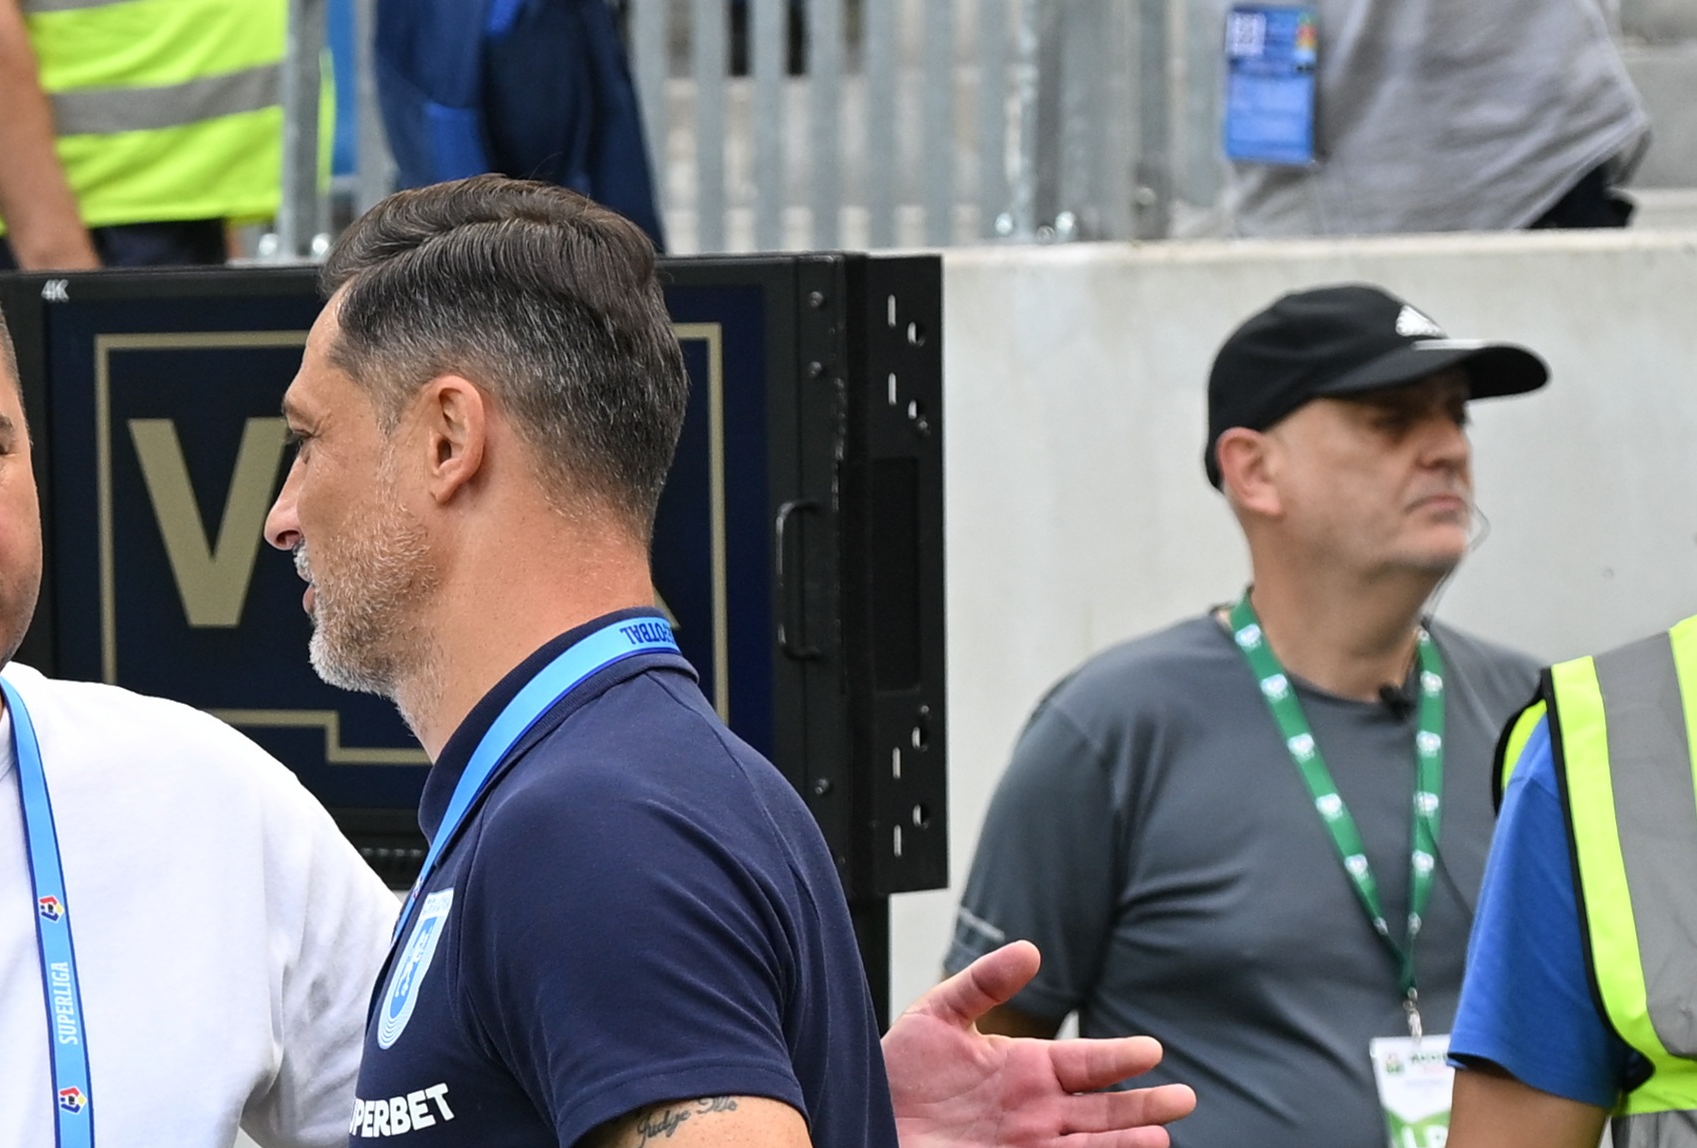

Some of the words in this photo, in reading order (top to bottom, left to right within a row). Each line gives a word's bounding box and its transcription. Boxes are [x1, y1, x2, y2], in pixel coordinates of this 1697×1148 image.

[41, 279, 70, 302] 4K
[50, 961, 78, 1045] SUPERLIGA
[349, 1082, 455, 1138] PERBET
